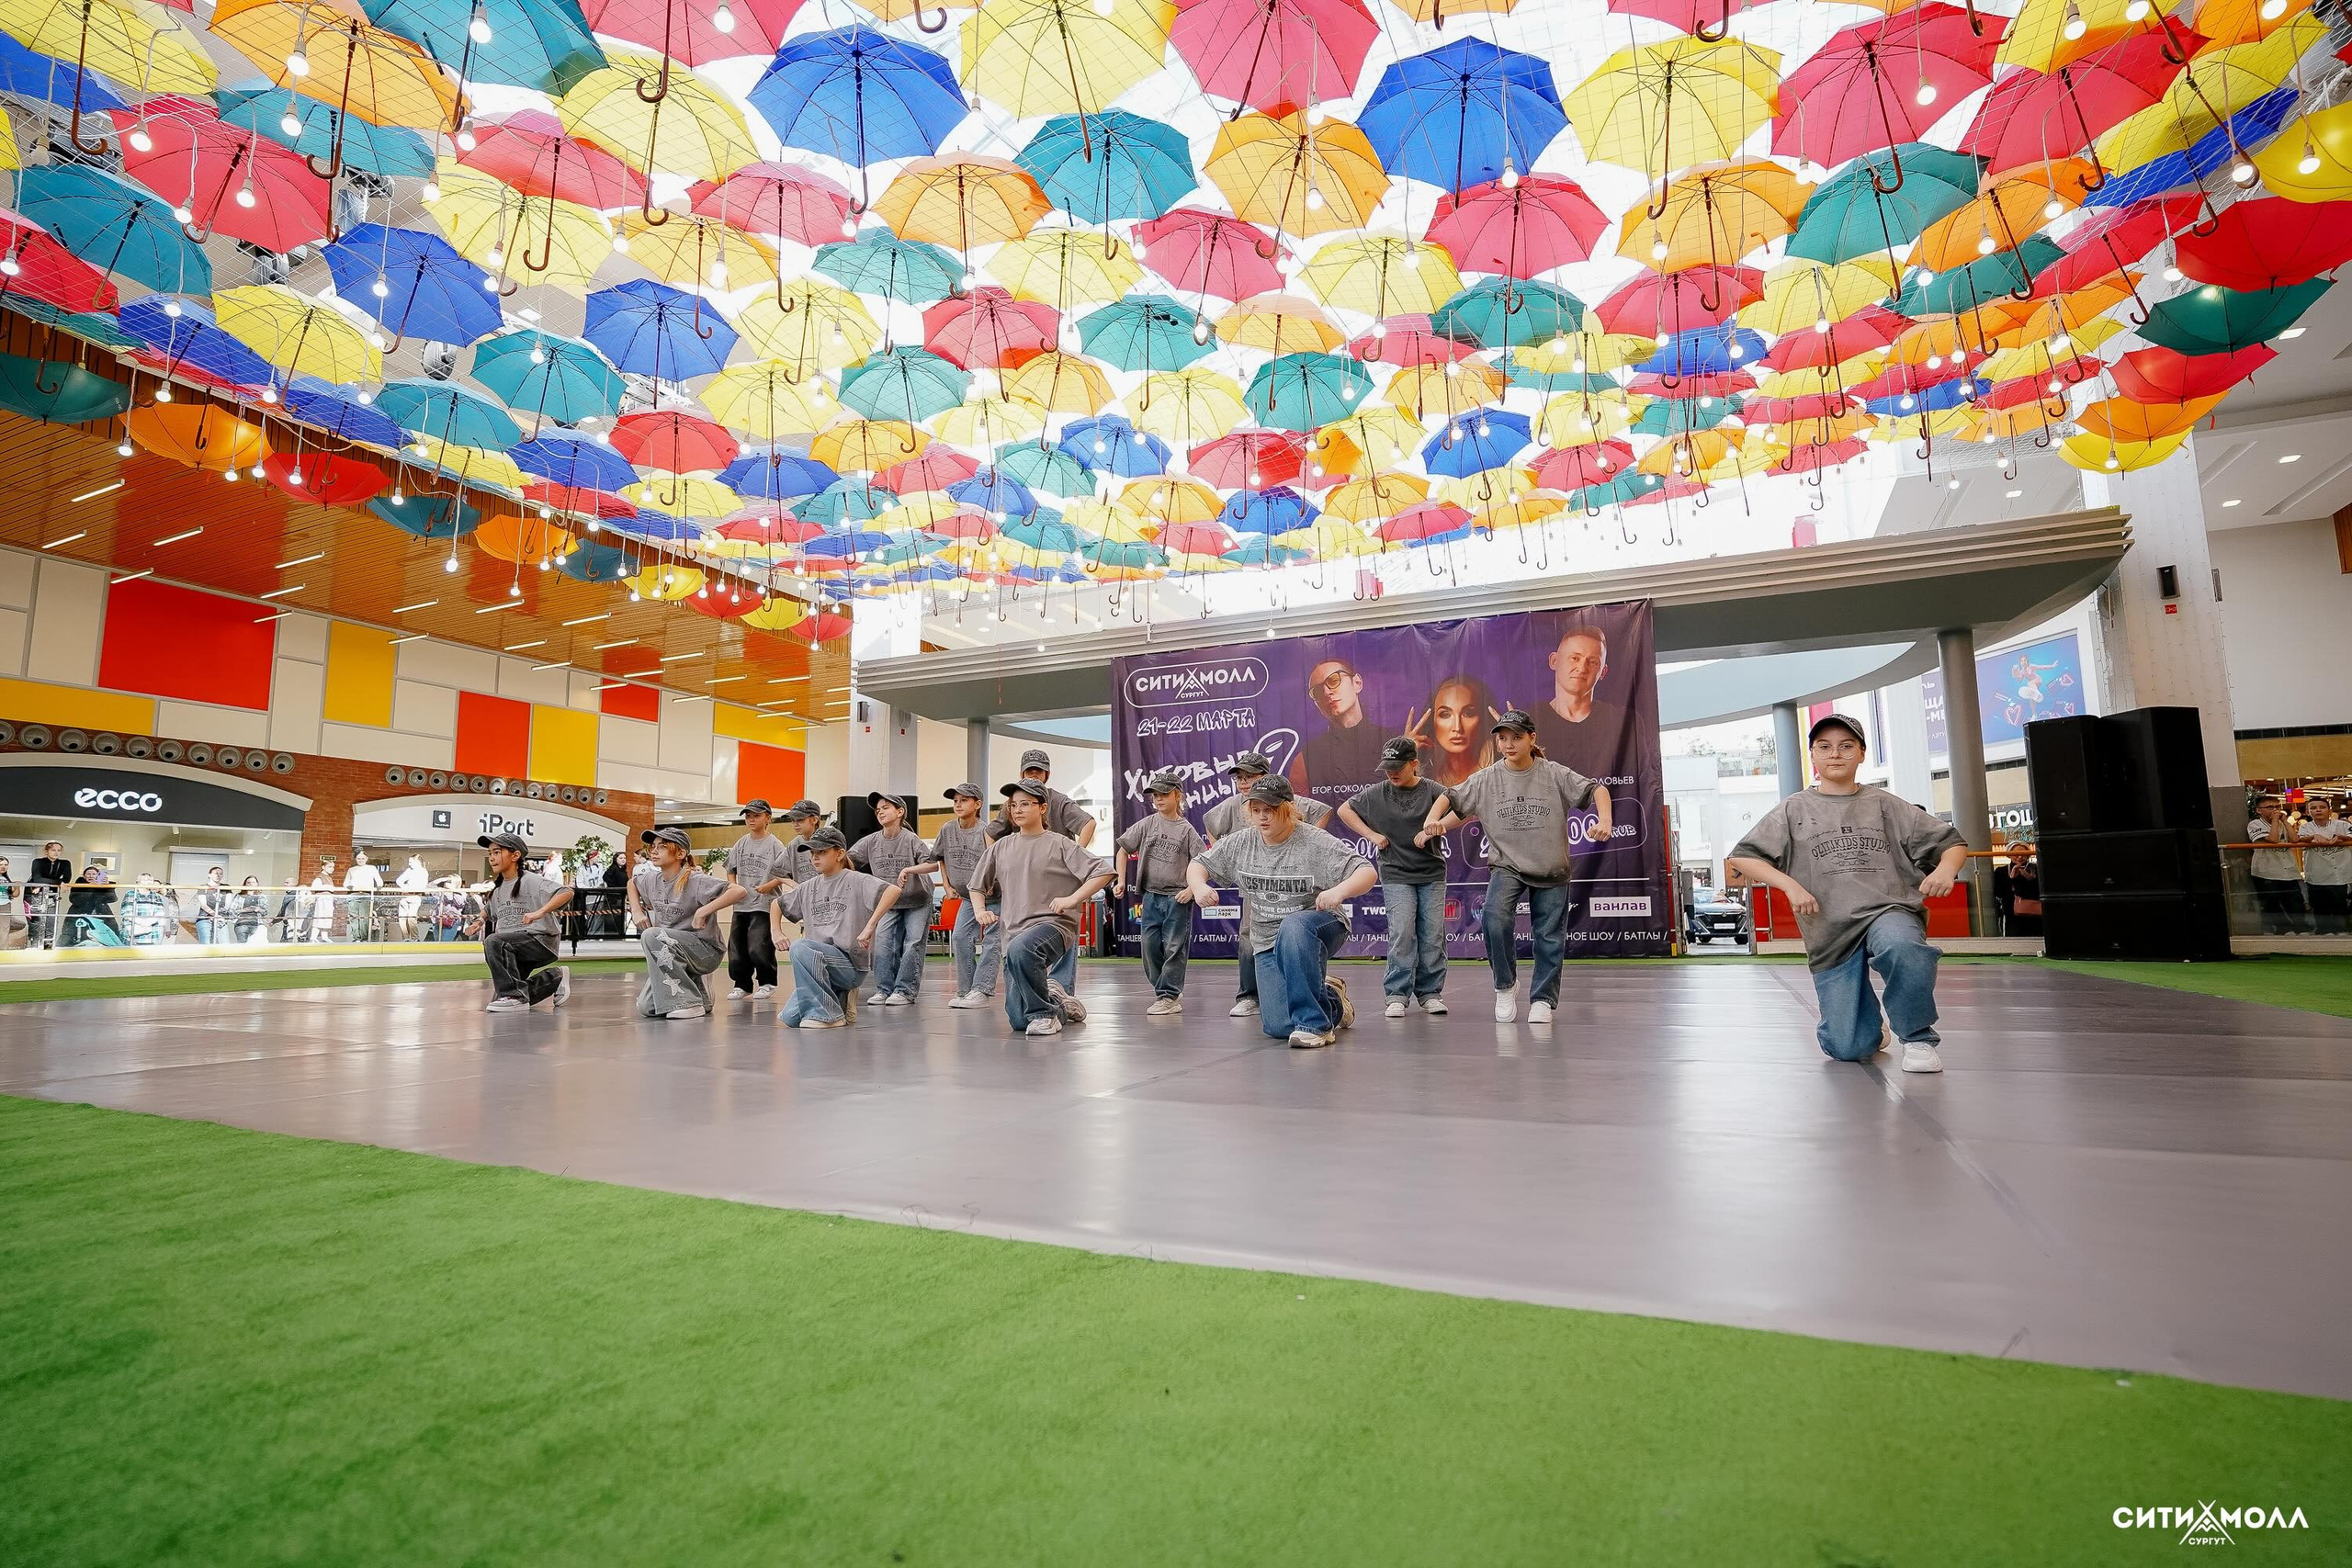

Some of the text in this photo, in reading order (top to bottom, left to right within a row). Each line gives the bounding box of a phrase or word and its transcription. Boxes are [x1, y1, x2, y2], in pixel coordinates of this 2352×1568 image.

[1199, 666, 1257, 686] МОЛЛ
[1181, 691, 1204, 699] СУРГУТ
[1136, 706, 1256, 737] 21-22 МАРТА
[1590, 775, 1634, 785] ОЛОВЬЕВ
[1311, 783, 1377, 795] ЕГОР СОКОЛО
[74, 787, 163, 812] ecco
[1528, 804, 1551, 818] STUDIO
[479, 813, 535, 837] iPort
[1859, 836, 1891, 855] STUDIO
[1594, 902, 1647, 911] ванлав
[1117, 933, 1142, 942] ТАНЦЕВ
[1199, 933, 1227, 942] БАТТЛЫ
[1589, 931, 1614, 942] ШОУ
[1623, 931, 1661, 941] БАТТЛЫ
